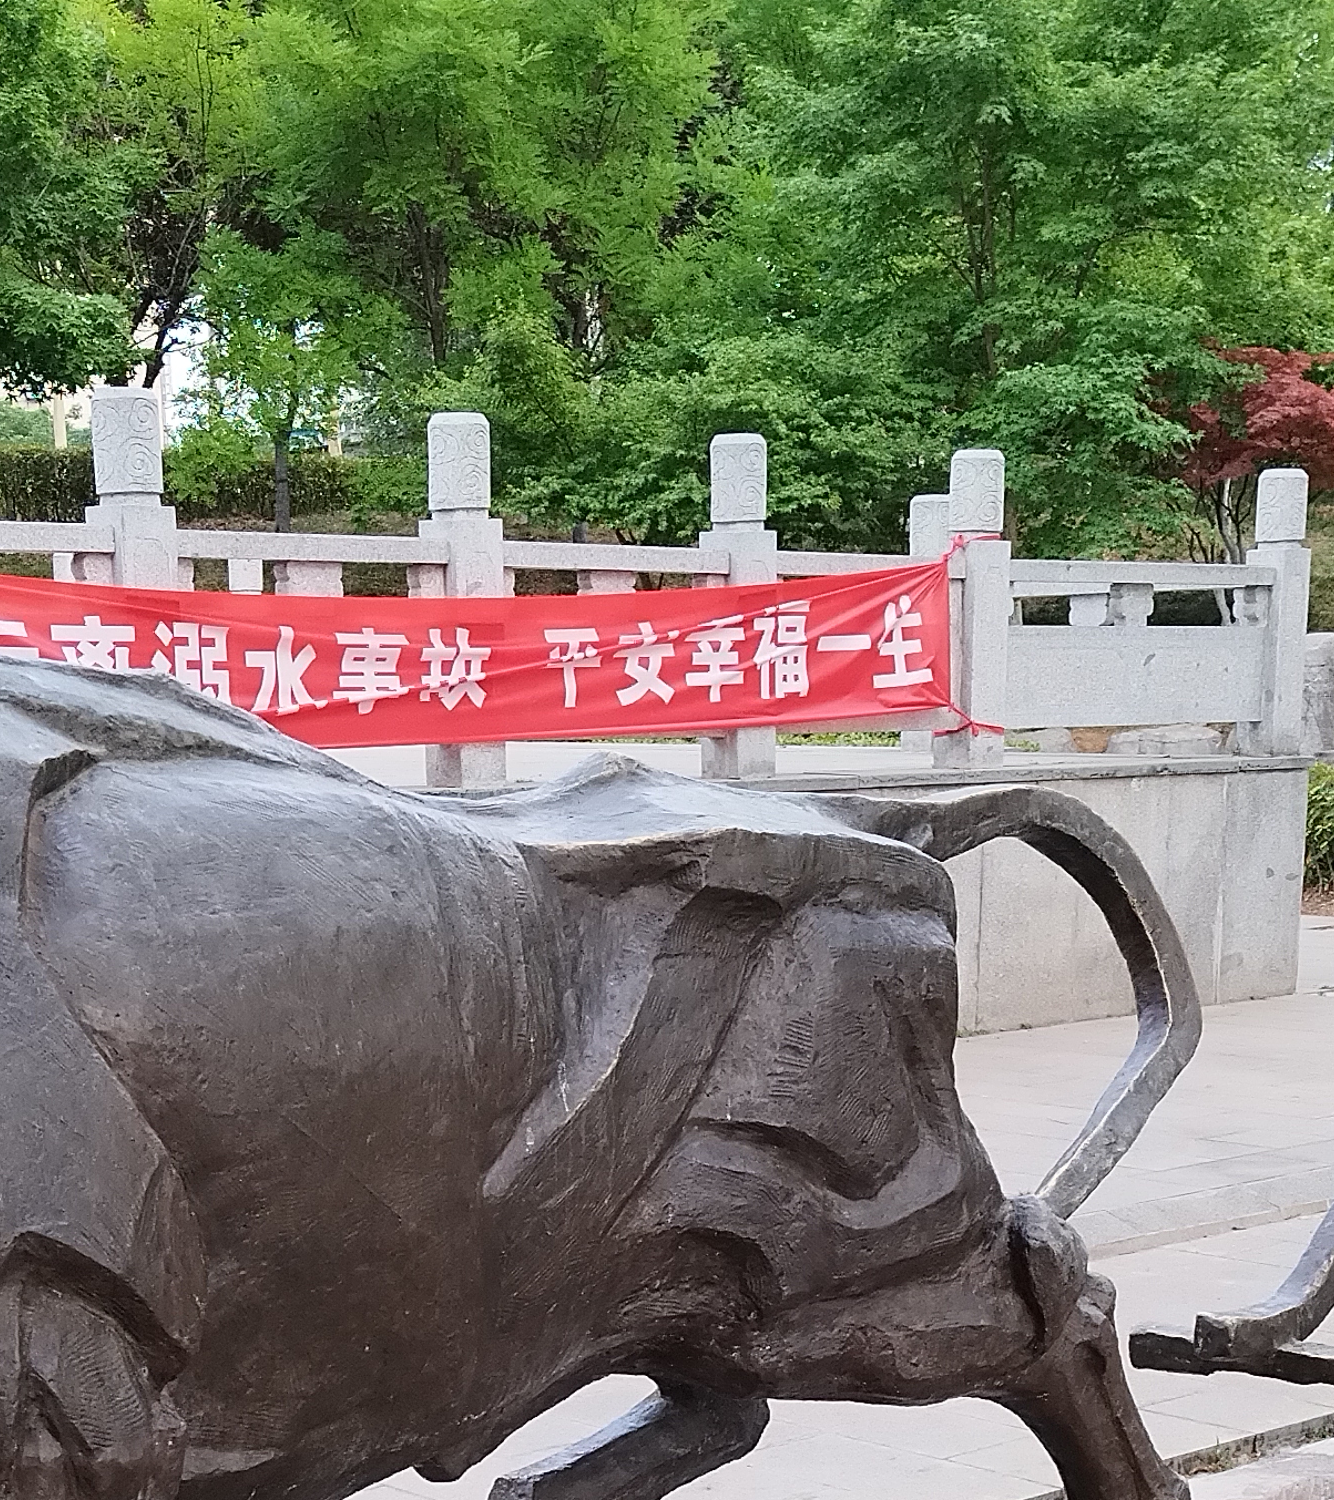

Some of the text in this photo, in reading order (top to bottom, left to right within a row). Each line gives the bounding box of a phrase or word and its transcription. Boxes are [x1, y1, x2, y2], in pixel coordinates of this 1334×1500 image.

[543, 595, 934, 708] 平安幸福一生
